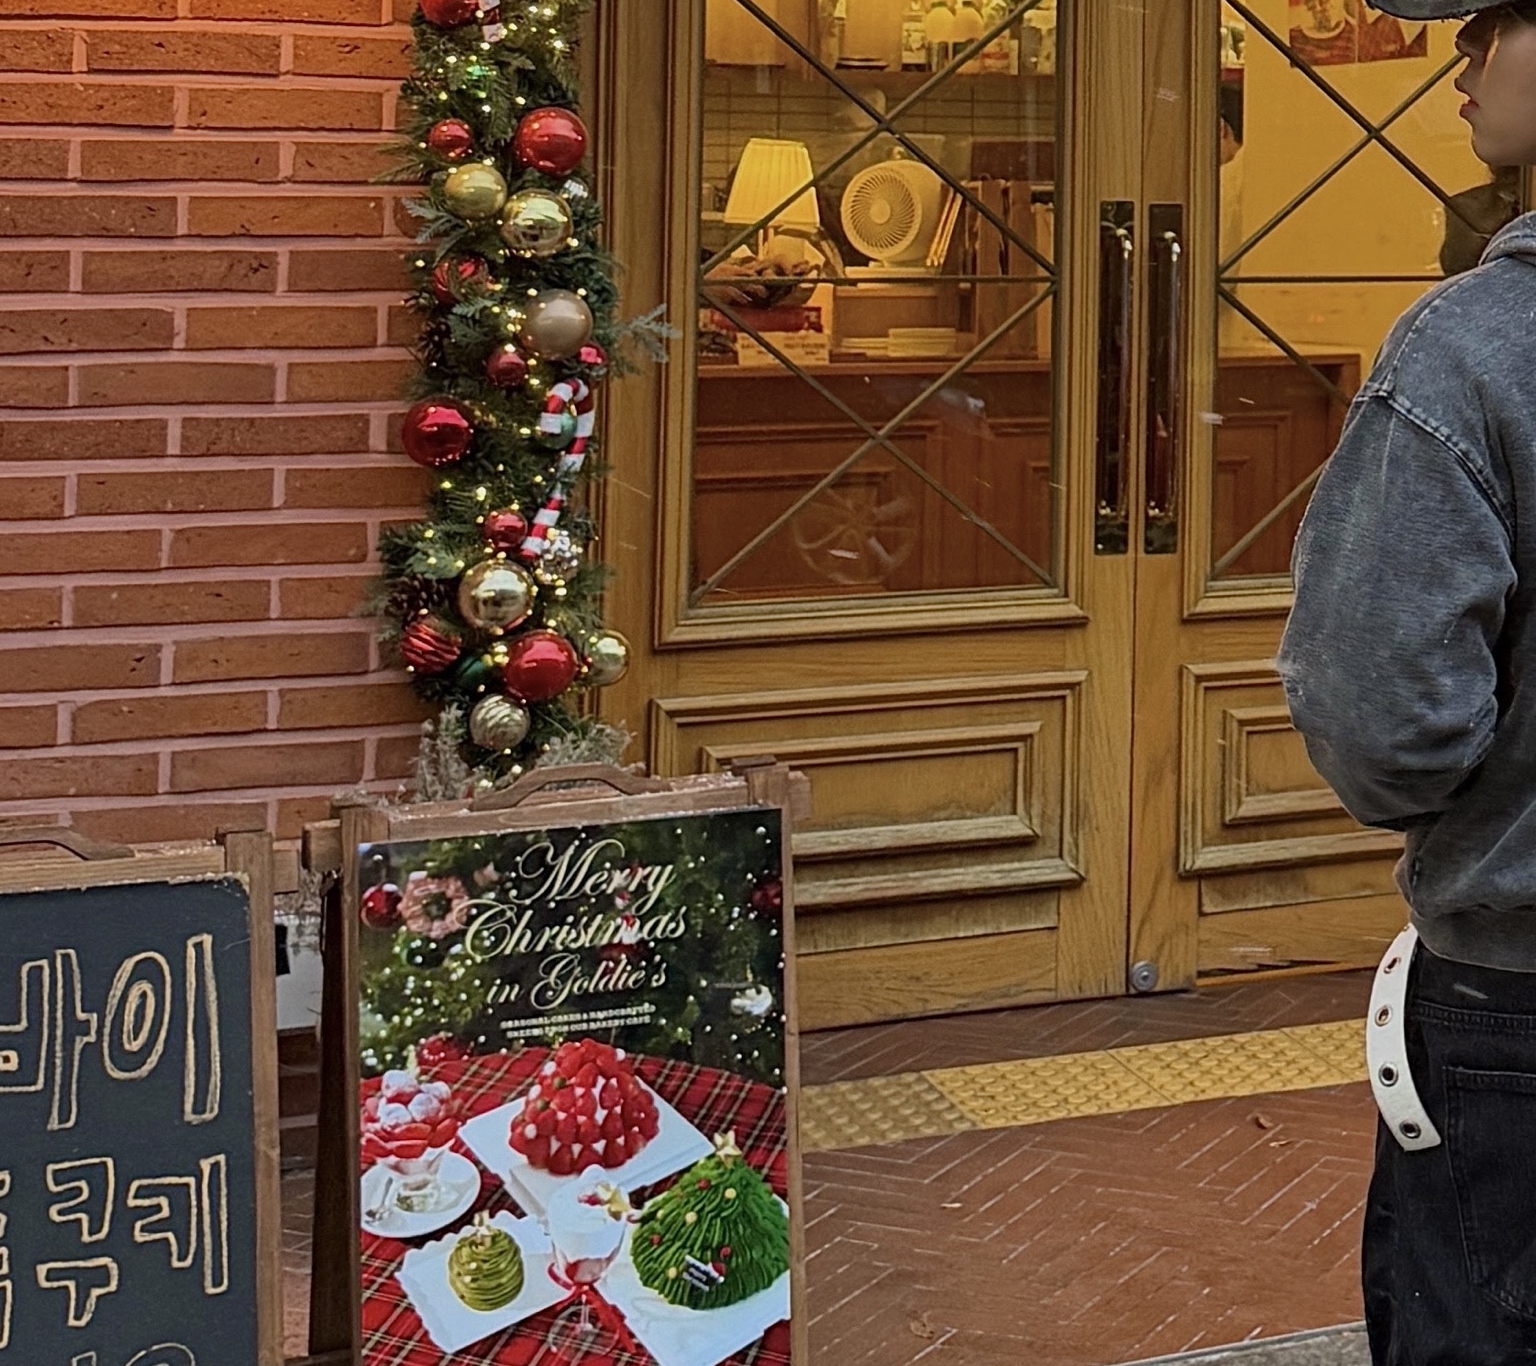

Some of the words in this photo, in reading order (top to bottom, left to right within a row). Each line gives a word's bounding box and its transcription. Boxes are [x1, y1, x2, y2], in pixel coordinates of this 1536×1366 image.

[509, 839, 677, 915] Merry
[452, 899, 687, 960] Christmas
[487, 978, 524, 1004] in
[530, 953, 667, 1010] Goldie's
[0, 1154, 228, 1348] 쿠키
